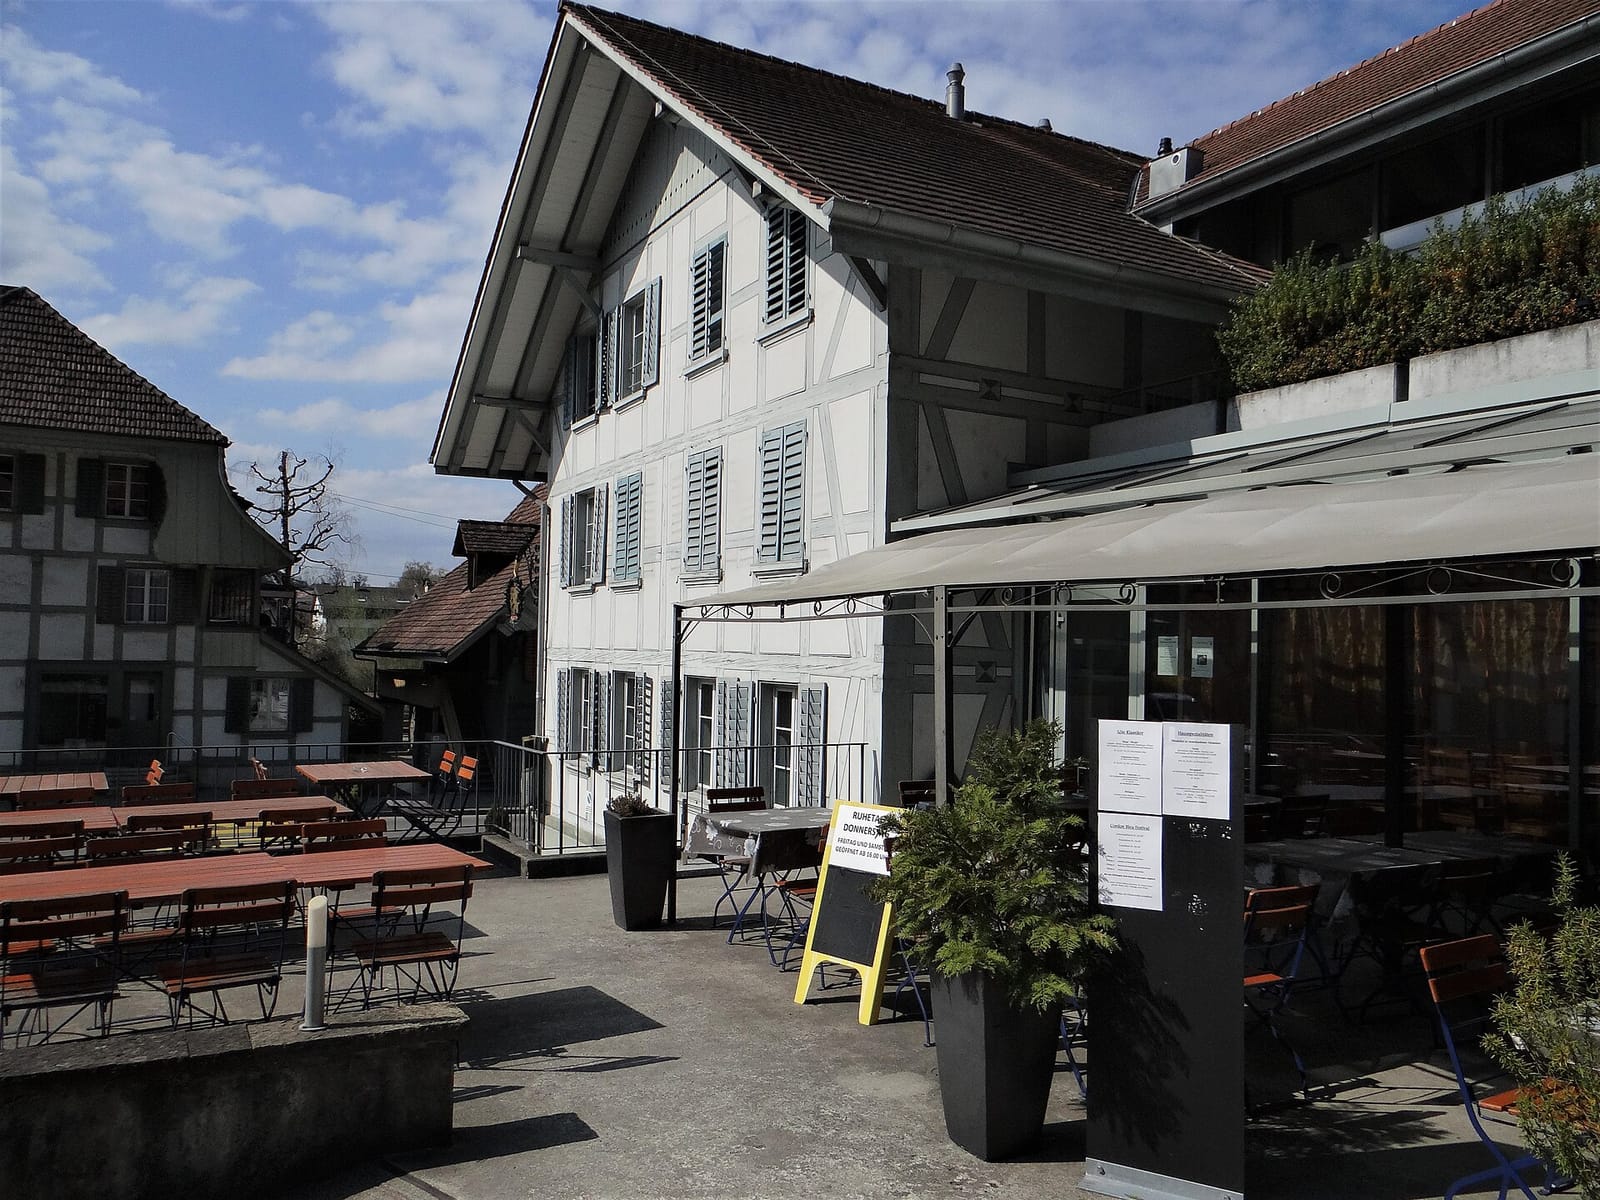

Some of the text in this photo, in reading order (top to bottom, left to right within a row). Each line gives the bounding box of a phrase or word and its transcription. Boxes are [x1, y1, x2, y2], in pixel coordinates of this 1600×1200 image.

[843, 823, 890, 838] DONNERSG
[837, 837, 884, 850] FREITAG UND SAMST
